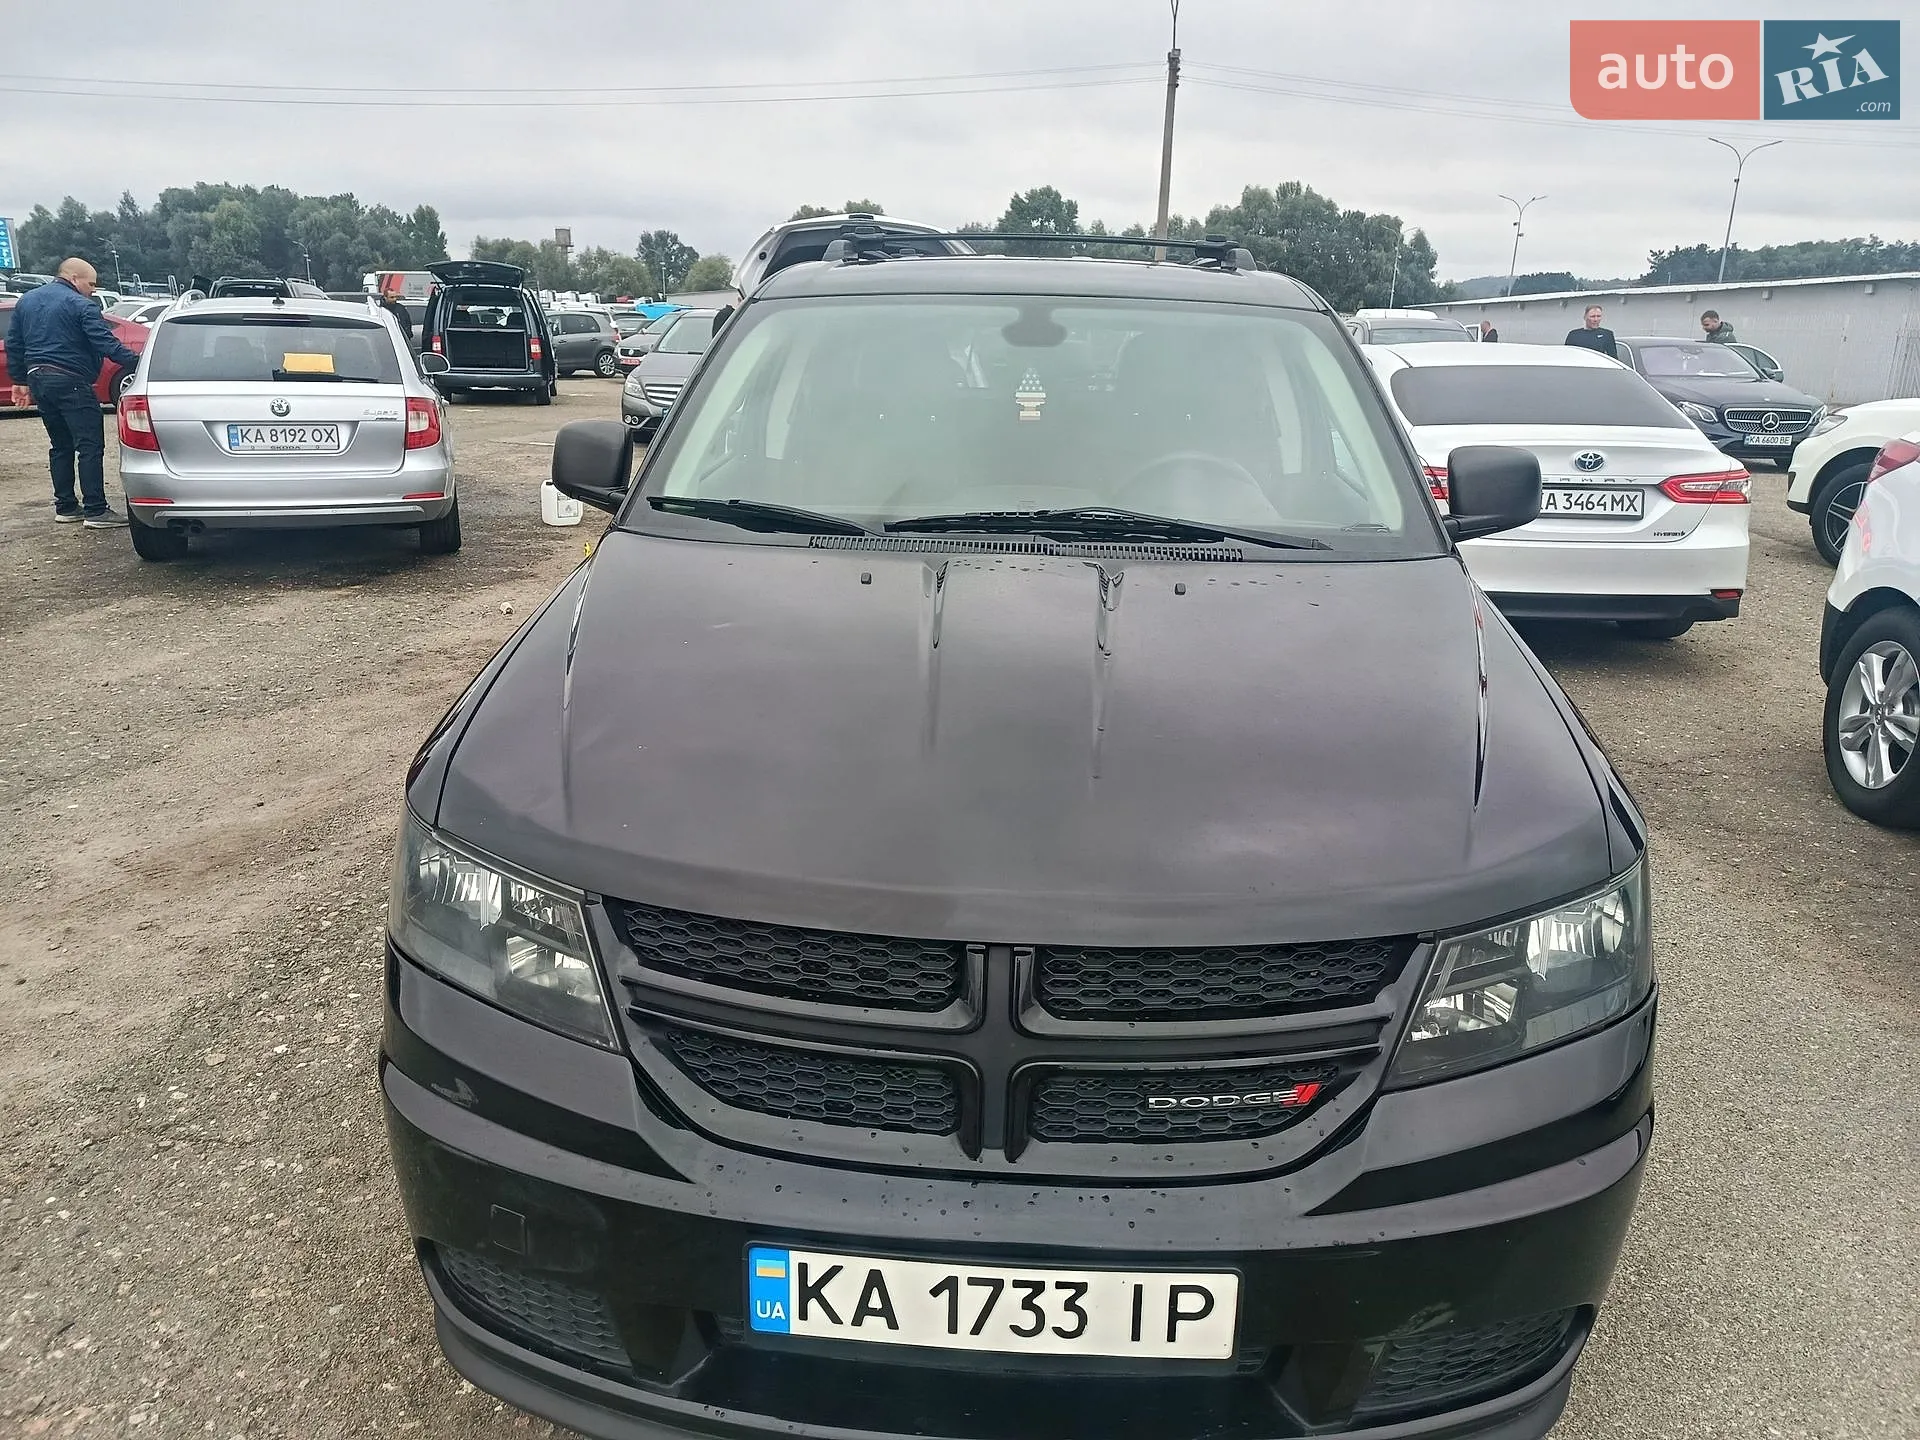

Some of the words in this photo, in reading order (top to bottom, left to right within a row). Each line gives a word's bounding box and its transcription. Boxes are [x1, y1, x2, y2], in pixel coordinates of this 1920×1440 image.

[240, 428, 265, 443] KA
[269, 428, 307, 443] 8192
[311, 428, 335, 443] OX
[1541, 492, 1558, 511] A
[1562, 493, 1607, 512] 3464
[1610, 494, 1638, 512] MX
[1148, 1089, 1299, 1109] DODGE
[756, 1299, 786, 1320] UA
[797, 1262, 900, 1331] KA
[928, 1275, 1089, 1340] 1733
[1130, 1283, 1215, 1343] IP
